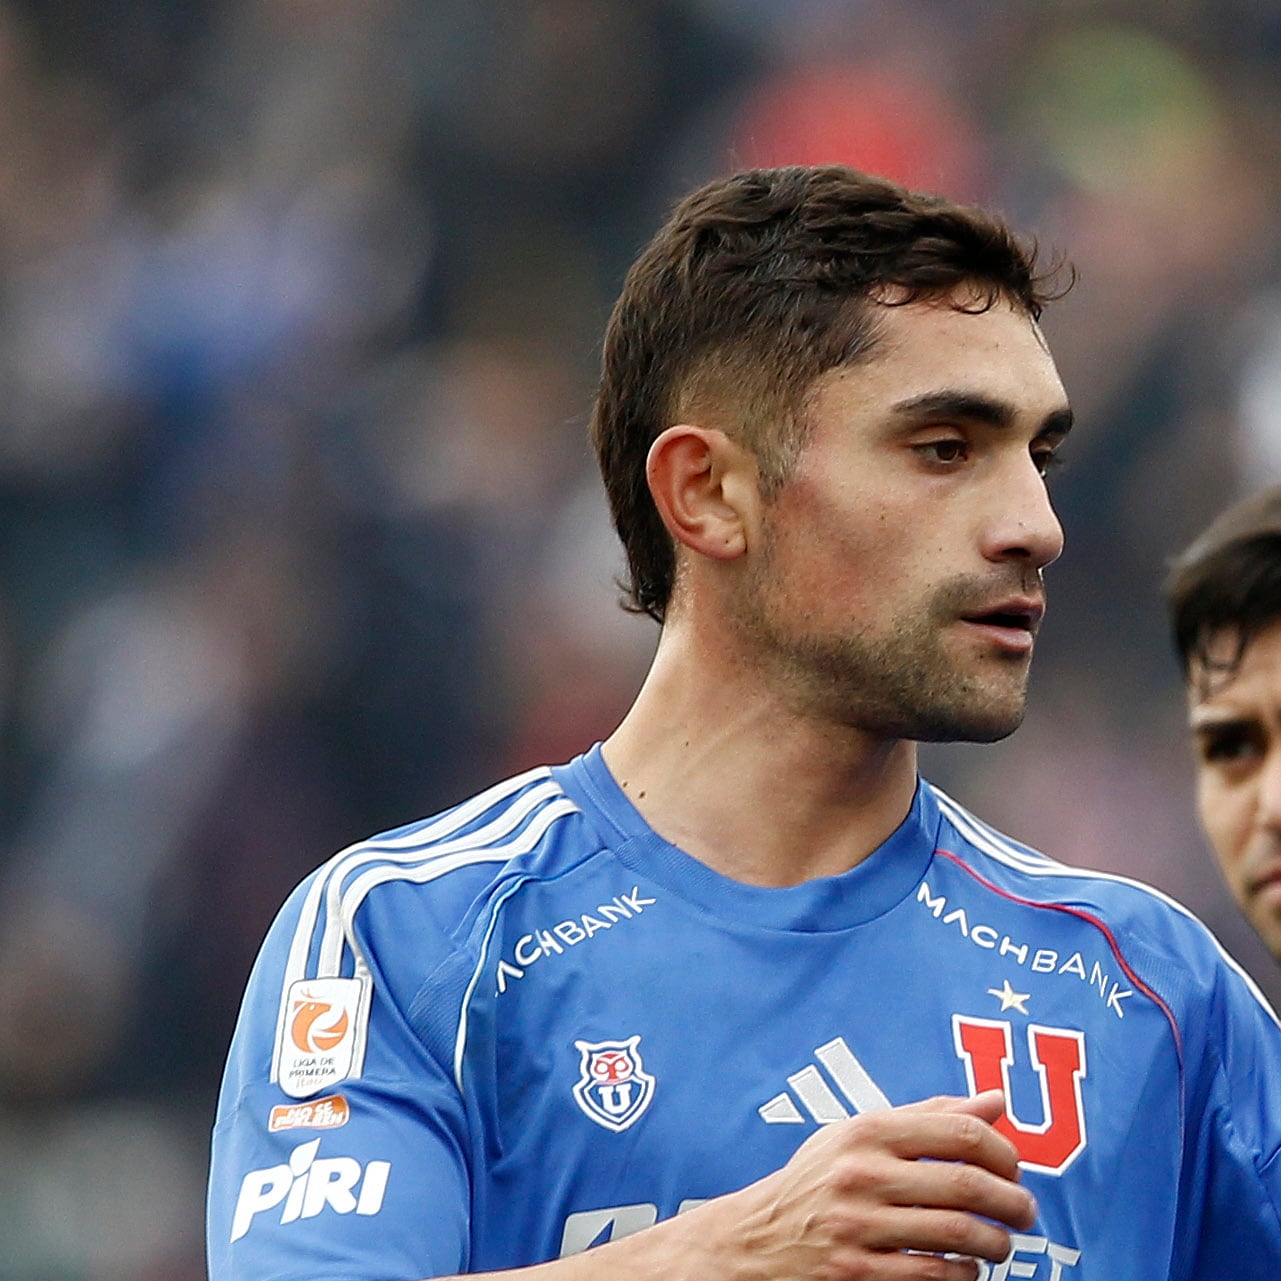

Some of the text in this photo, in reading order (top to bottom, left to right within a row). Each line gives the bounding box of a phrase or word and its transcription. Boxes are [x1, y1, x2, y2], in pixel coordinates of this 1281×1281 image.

[495, 886, 656, 998] ACHBANK
[917, 881, 1134, 1018] MACHBANK
[952, 1014, 1087, 1177] U
